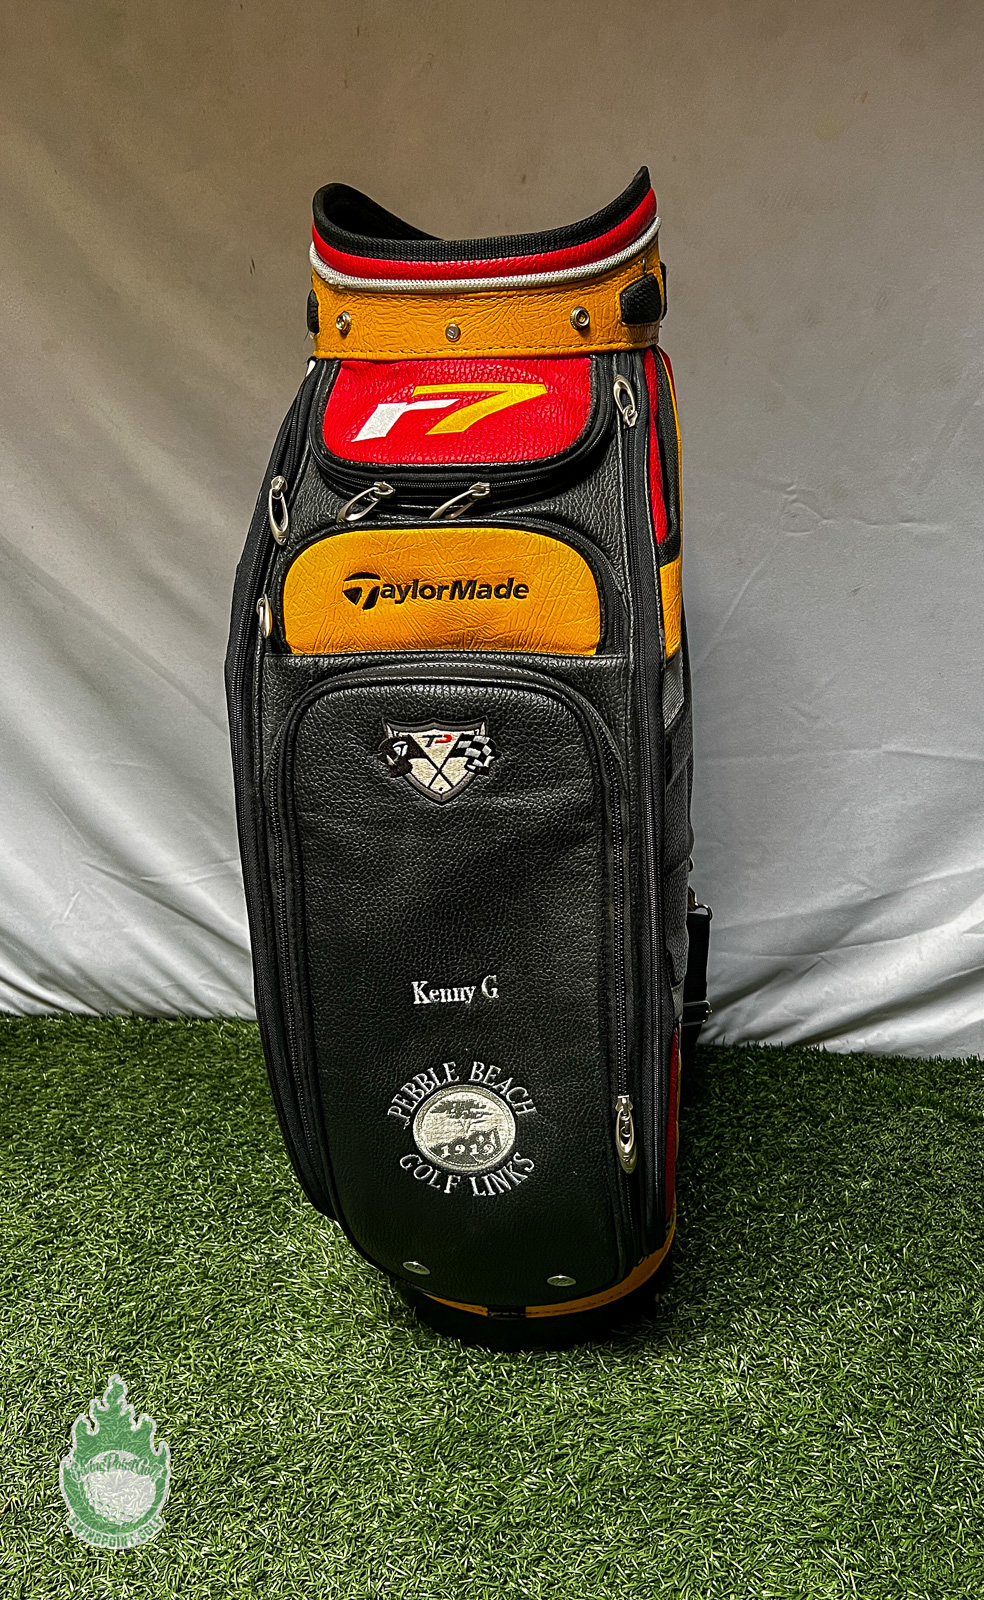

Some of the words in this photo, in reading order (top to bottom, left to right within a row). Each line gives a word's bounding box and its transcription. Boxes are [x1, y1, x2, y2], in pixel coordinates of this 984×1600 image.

[350, 382, 548, 442] r7
[342, 571, 530, 610] TaylorMade
[411, 980, 477, 1005] Kenny
[481, 975, 499, 999] G
[387, 1061, 460, 1121] PEBBLE
[468, 1061, 538, 1117] BEACH
[440, 1143, 495, 1159] 1919
[399, 1153, 461, 1194] GOLF
[469, 1152, 535, 1197] LINKS
